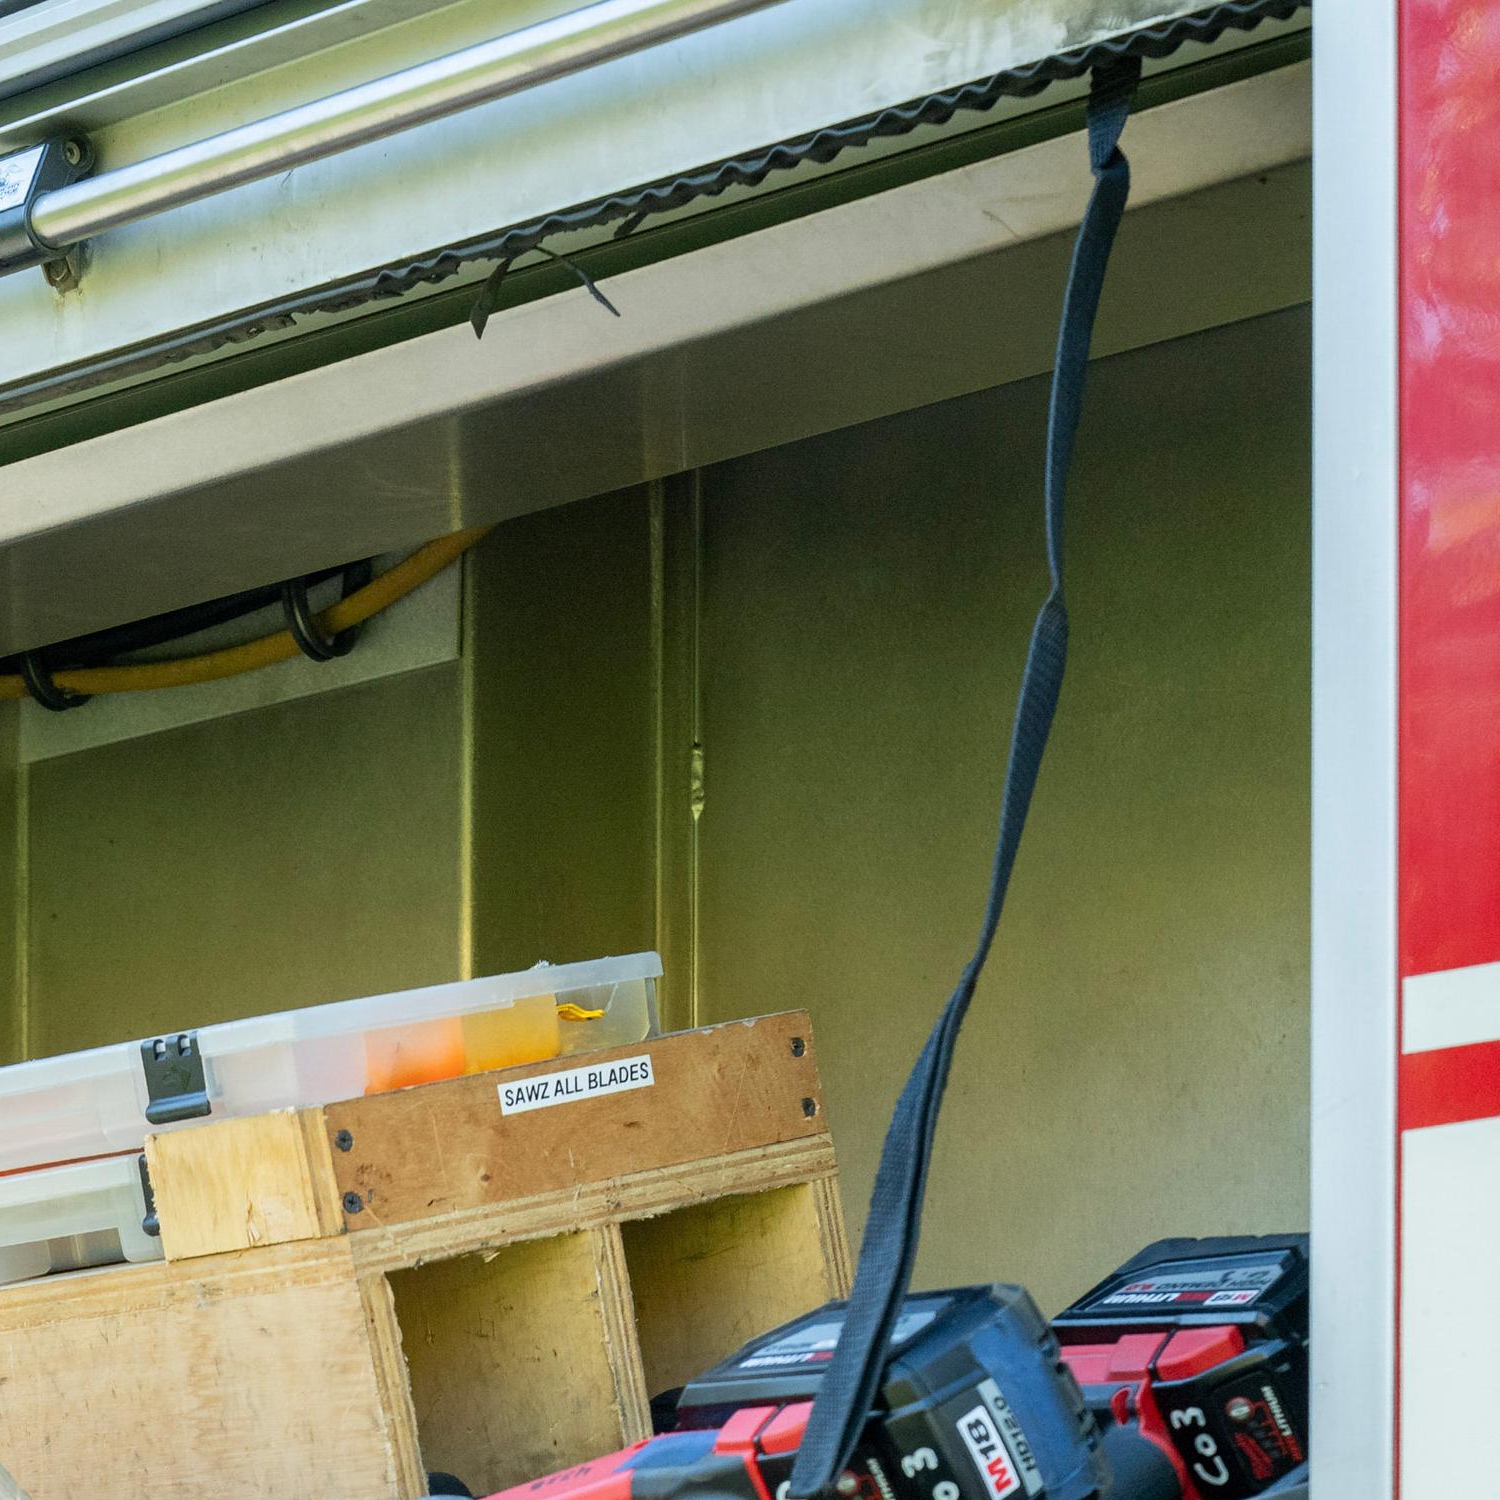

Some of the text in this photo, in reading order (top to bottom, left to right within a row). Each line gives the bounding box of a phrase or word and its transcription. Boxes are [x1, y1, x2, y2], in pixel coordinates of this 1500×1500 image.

[504, 1061, 650, 1107] SAWZ ALL BLADES
[900, 1446, 939, 1479] 3
[966, 1417, 1014, 1495] M18
